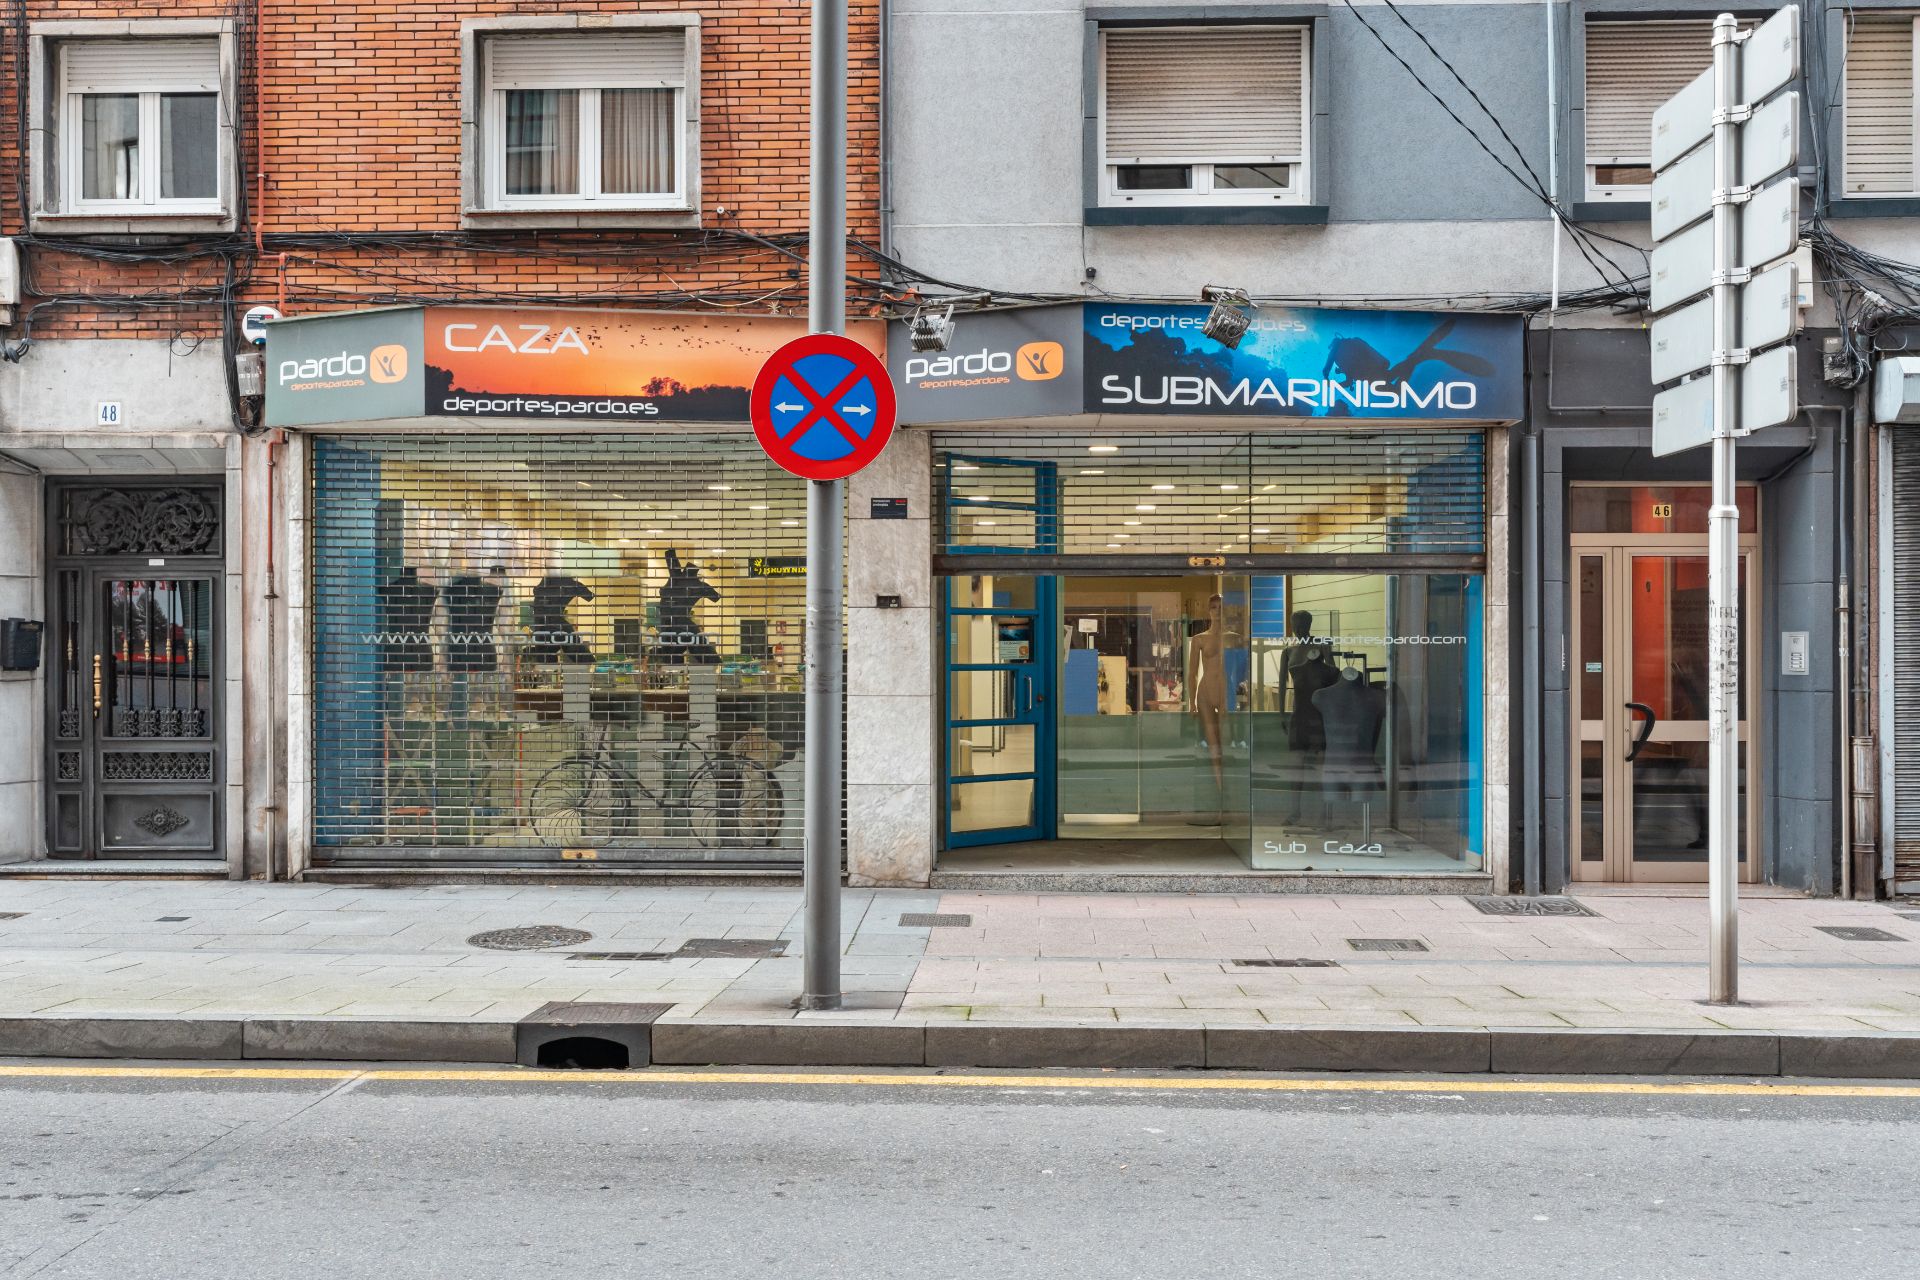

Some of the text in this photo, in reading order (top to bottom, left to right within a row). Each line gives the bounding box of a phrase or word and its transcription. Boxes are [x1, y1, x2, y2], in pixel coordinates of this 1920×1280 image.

[445, 323, 589, 355] CAZA
[280, 351, 366, 386] pardo
[906, 348, 1012, 384] pardo
[919, 376, 1010, 389] deportespardo.es
[1102, 375, 1477, 410] SUBMARINISMO
[102, 405, 117, 422] 48
[443, 396, 659, 416] deportespardo.es
[1655, 506, 1670, 517] 46
[1267, 635, 1467, 647] www.deportespardo.com
[1264, 840, 1383, 854] Sub Caza
